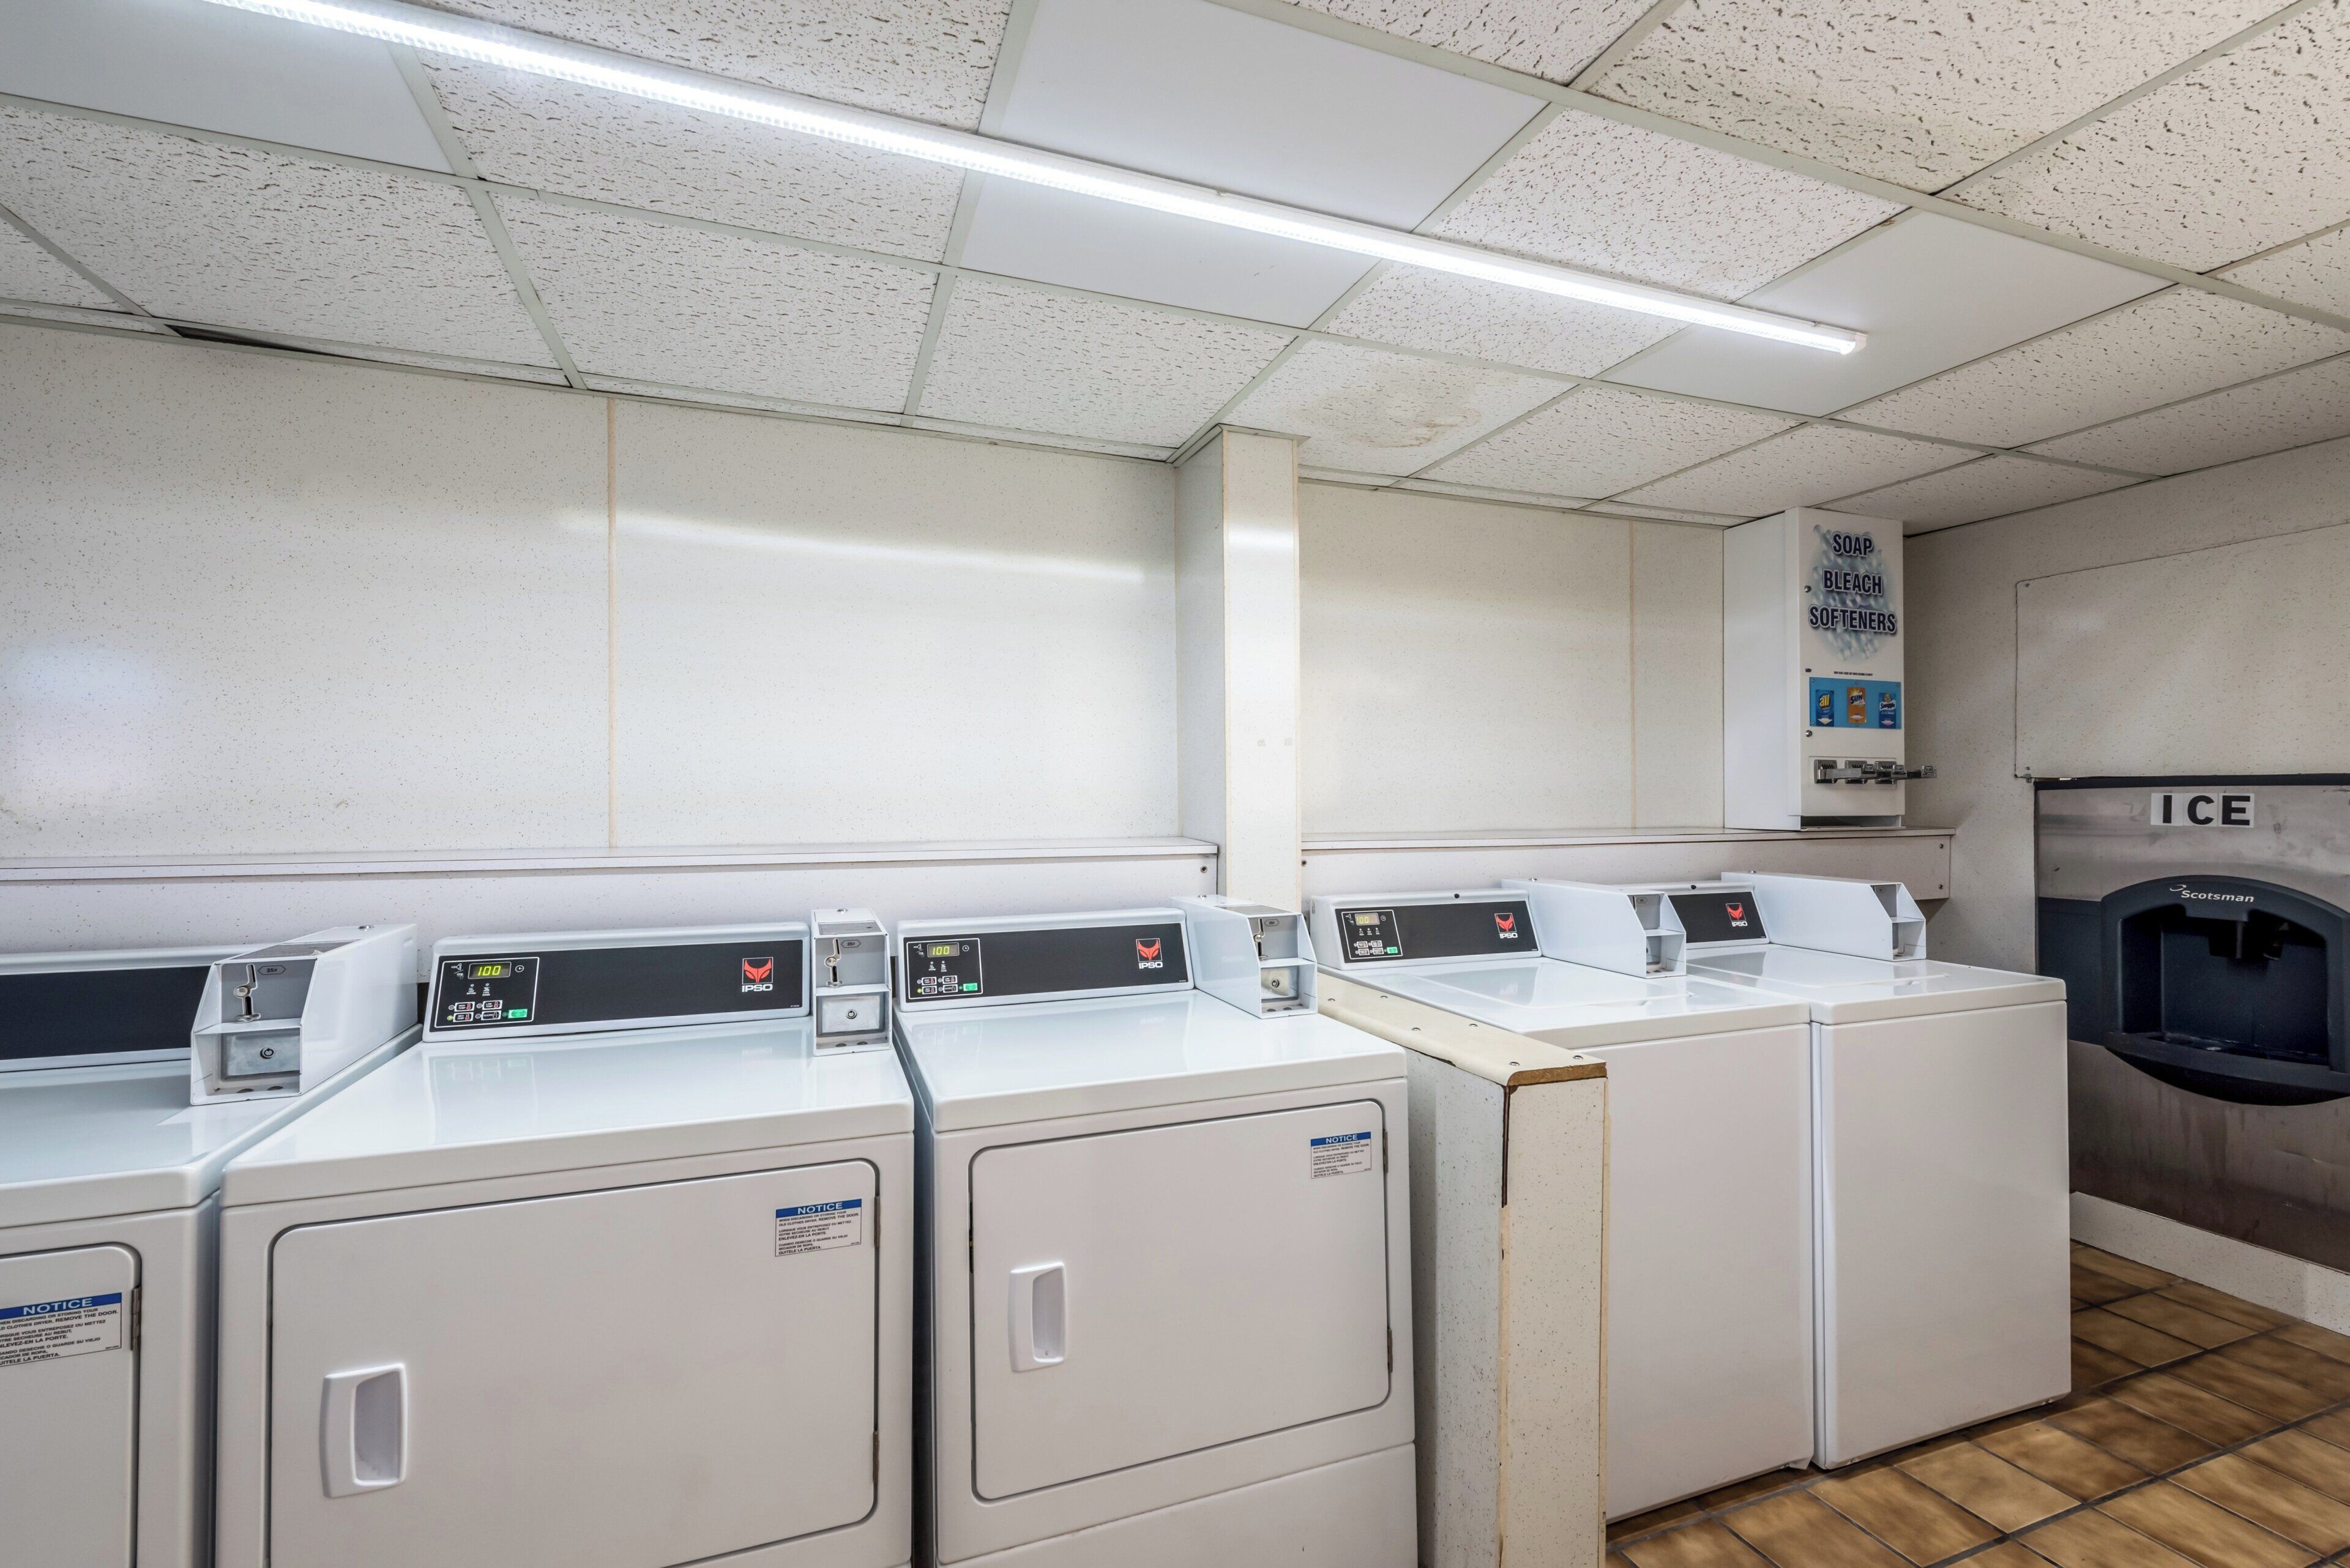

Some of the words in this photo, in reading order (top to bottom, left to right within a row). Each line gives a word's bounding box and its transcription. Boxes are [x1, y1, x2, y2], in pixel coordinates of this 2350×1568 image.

[1832, 532, 1873, 556] SOAP
[1823, 569, 1882, 594] BLEACH
[1809, 605, 1896, 633] SOFTENERS
[1851, 695, 1862, 703] SUN
[2163, 795, 2250, 826] ICE
[2181, 890, 2254, 902] Scotsman
[933, 946, 949, 955] 100
[478, 966, 501, 976] 100
[742, 984, 773, 992] IPSO
[1326, 1134, 1358, 1143] NOTICE
[797, 1202, 843, 1214] NOTICE
[23, 1298, 92, 1315] NOTICE
